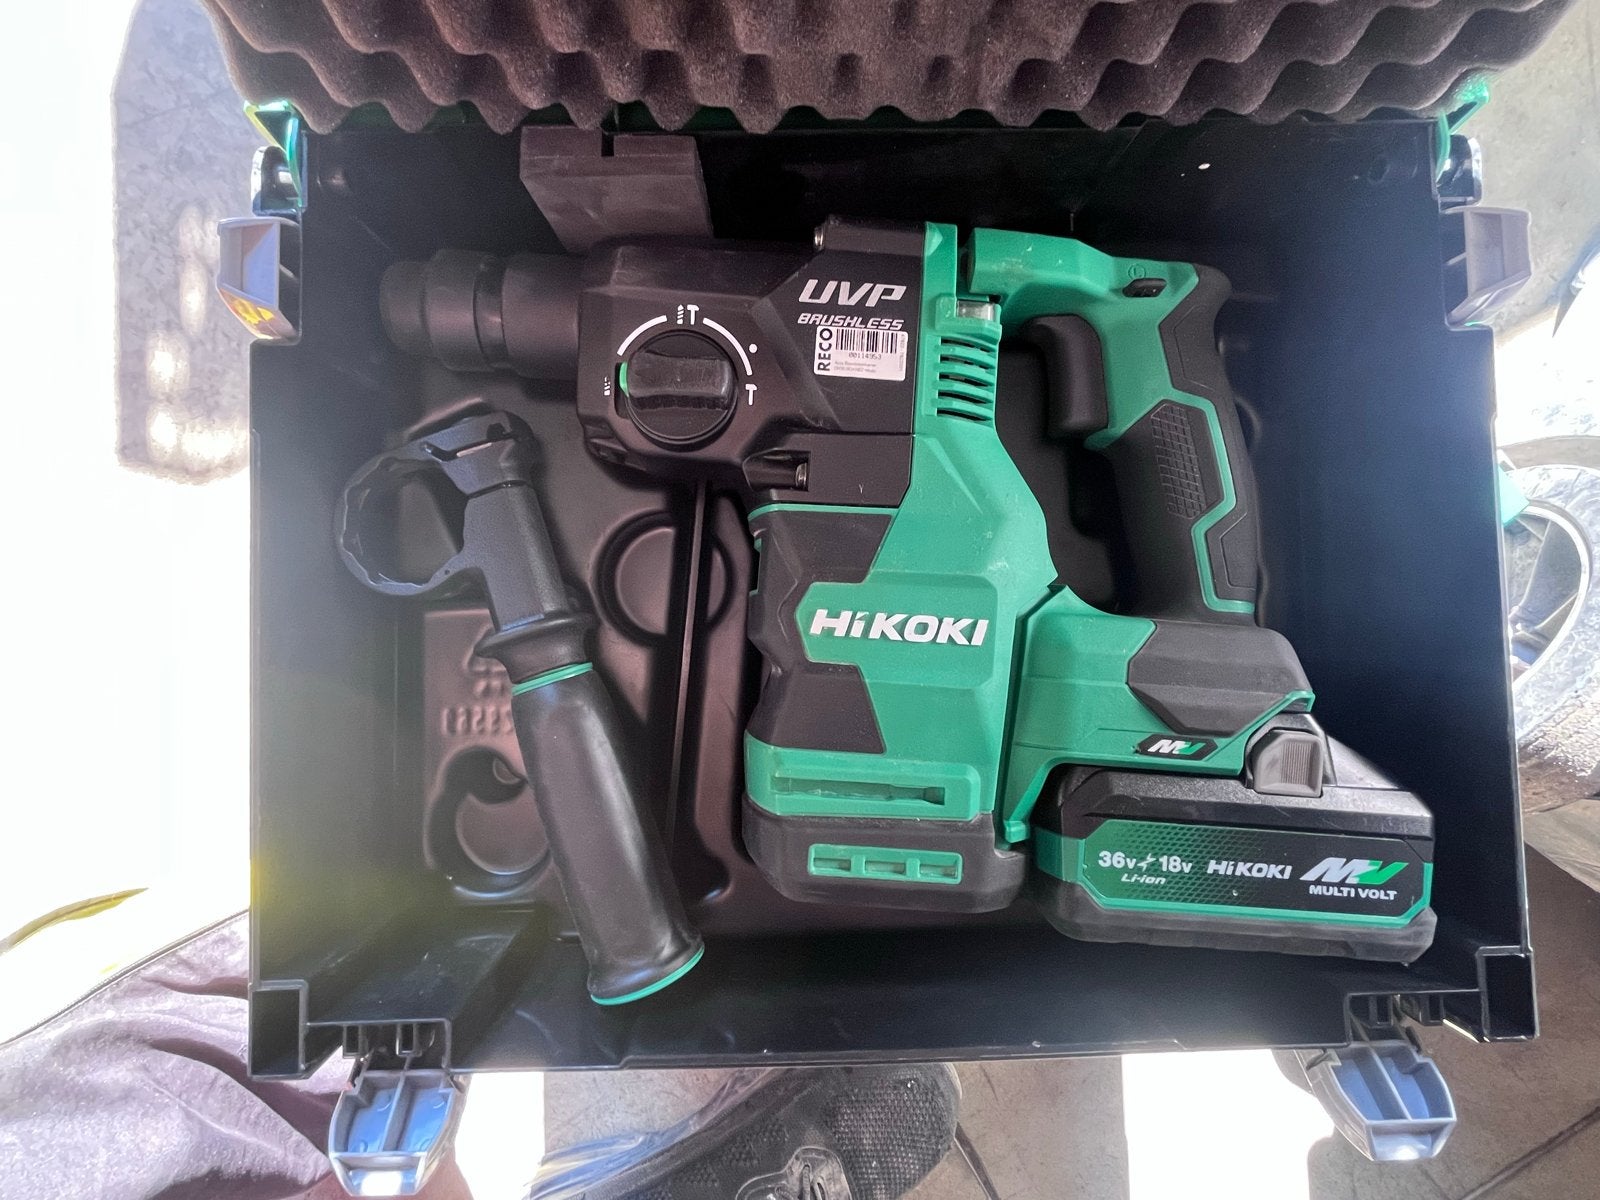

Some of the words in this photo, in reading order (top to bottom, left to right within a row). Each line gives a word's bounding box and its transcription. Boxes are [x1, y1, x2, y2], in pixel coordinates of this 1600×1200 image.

[798, 279, 907, 307] UVP
[797, 312, 904, 331] BRUSHLESS
[817, 327, 833, 372] RECO
[1121, 873, 1166, 885] Li-ion
[1309, 884, 1354, 898] MULTI
[1358, 887, 1398, 900] VOLT
